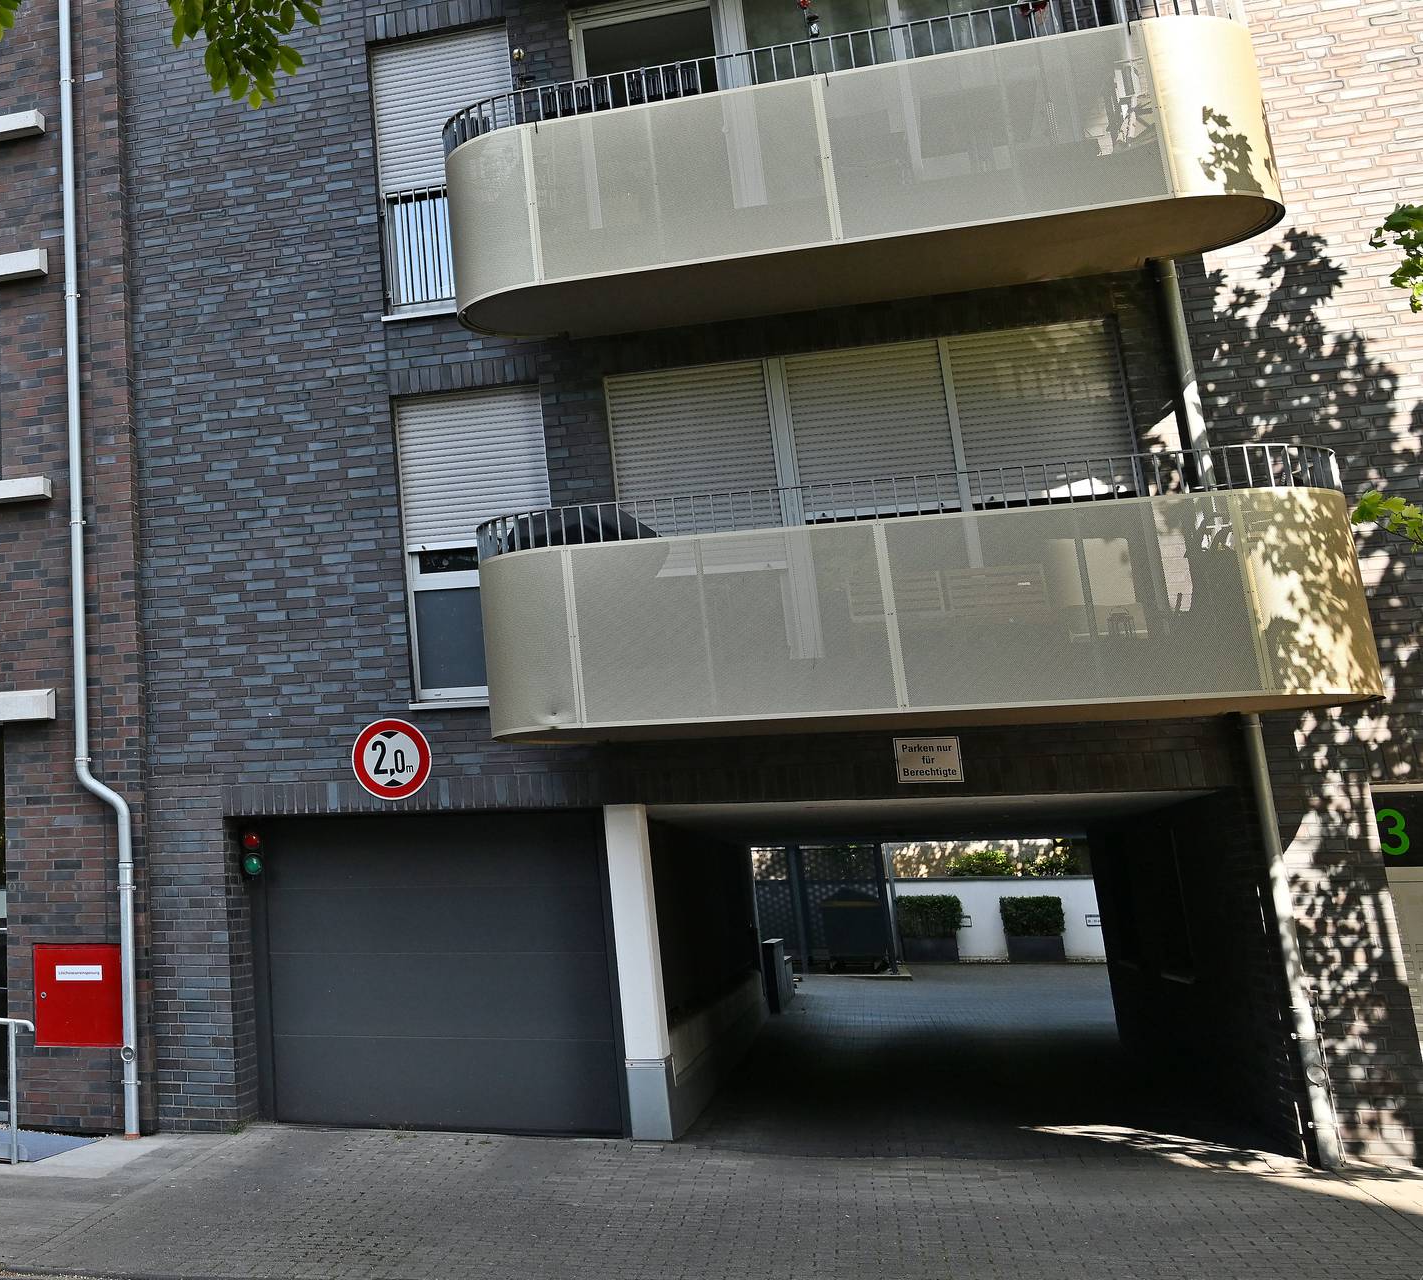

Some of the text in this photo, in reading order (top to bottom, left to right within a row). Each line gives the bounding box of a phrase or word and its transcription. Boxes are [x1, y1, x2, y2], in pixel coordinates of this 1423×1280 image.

[901, 744, 934, 752] Parken
[921, 755, 935, 764] für
[903, 767, 957, 777] Berechtigte
[1377, 808, 1410, 855] 3
